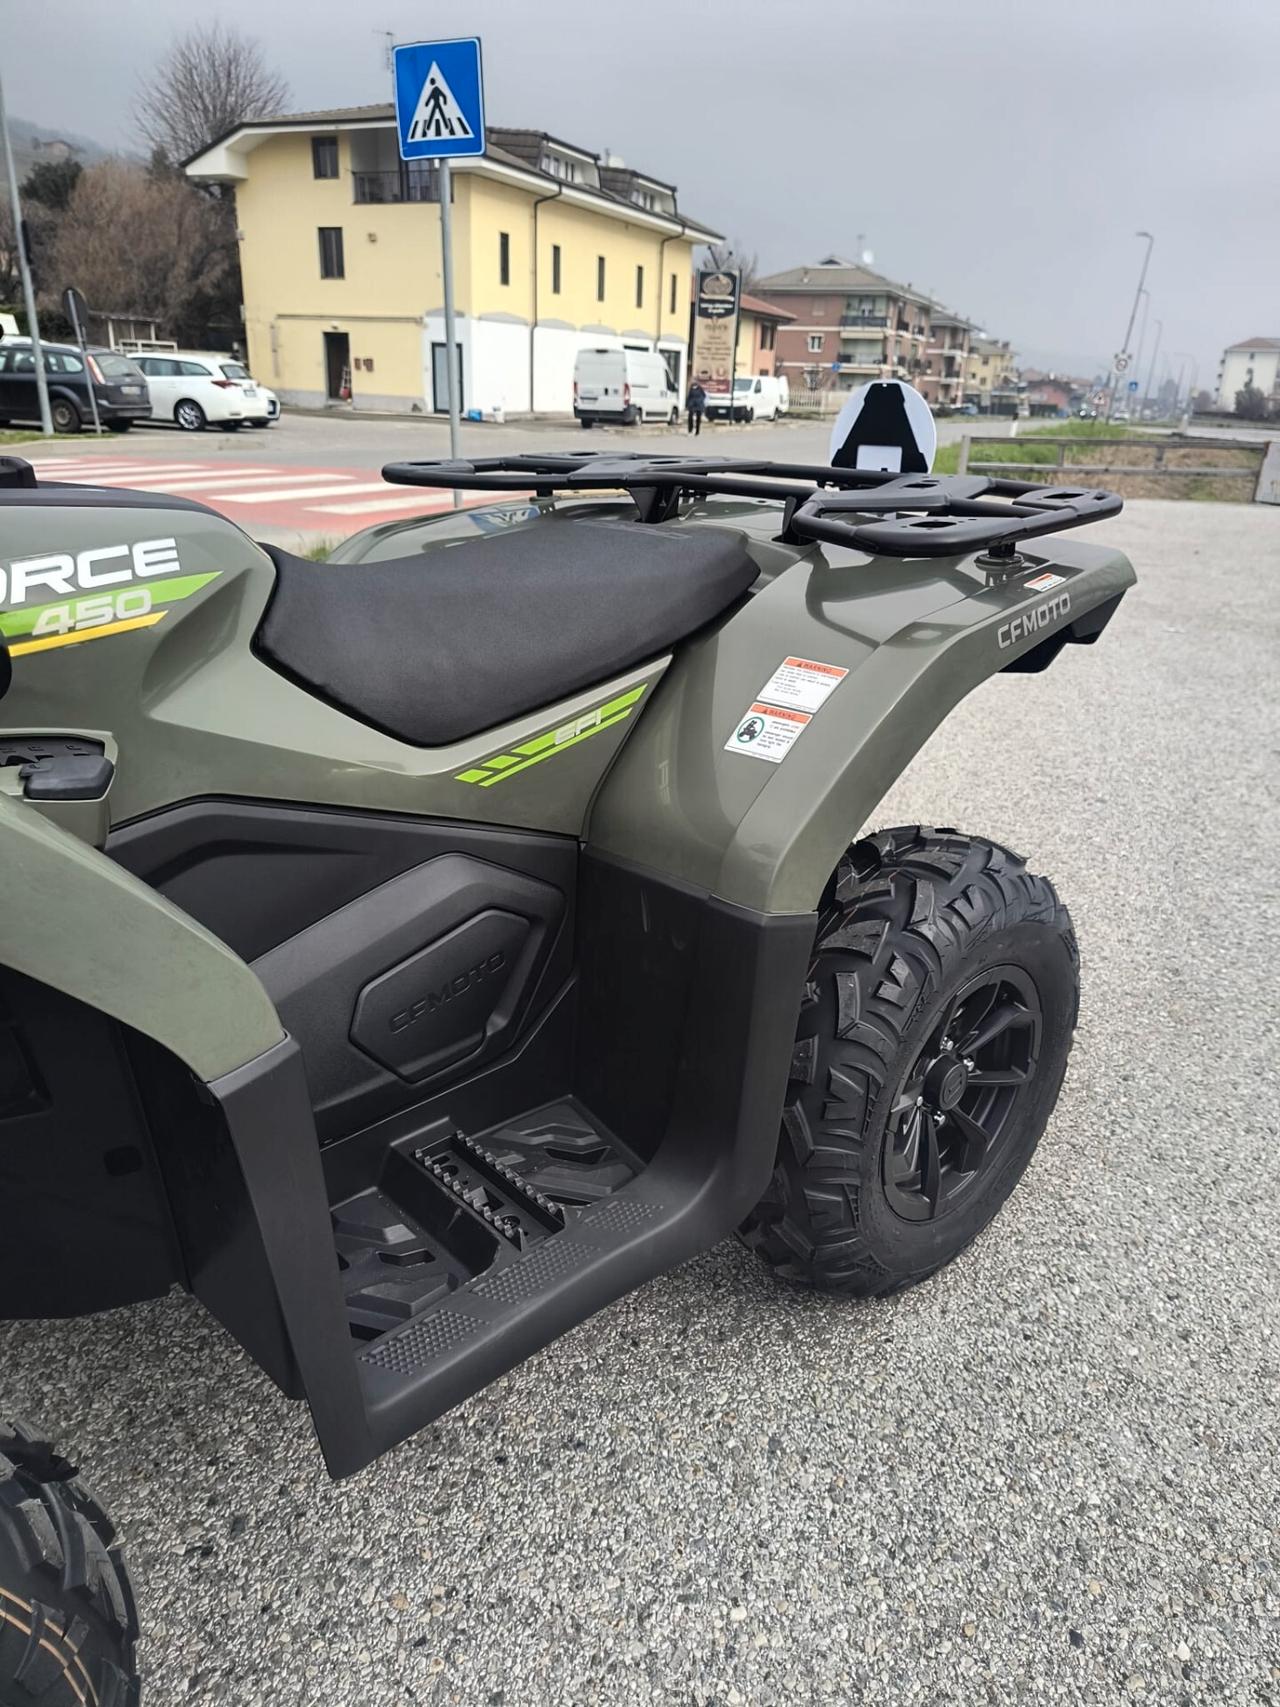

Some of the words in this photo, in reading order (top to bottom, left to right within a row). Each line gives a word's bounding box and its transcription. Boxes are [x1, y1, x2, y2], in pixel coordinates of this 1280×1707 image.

[0, 537, 181, 604] RCE
[32, 589, 152, 636] 450
[998, 593, 1071, 648] CFMOTO
[554, 707, 602, 745] EFI
[390, 951, 506, 1034] CFMOTO
